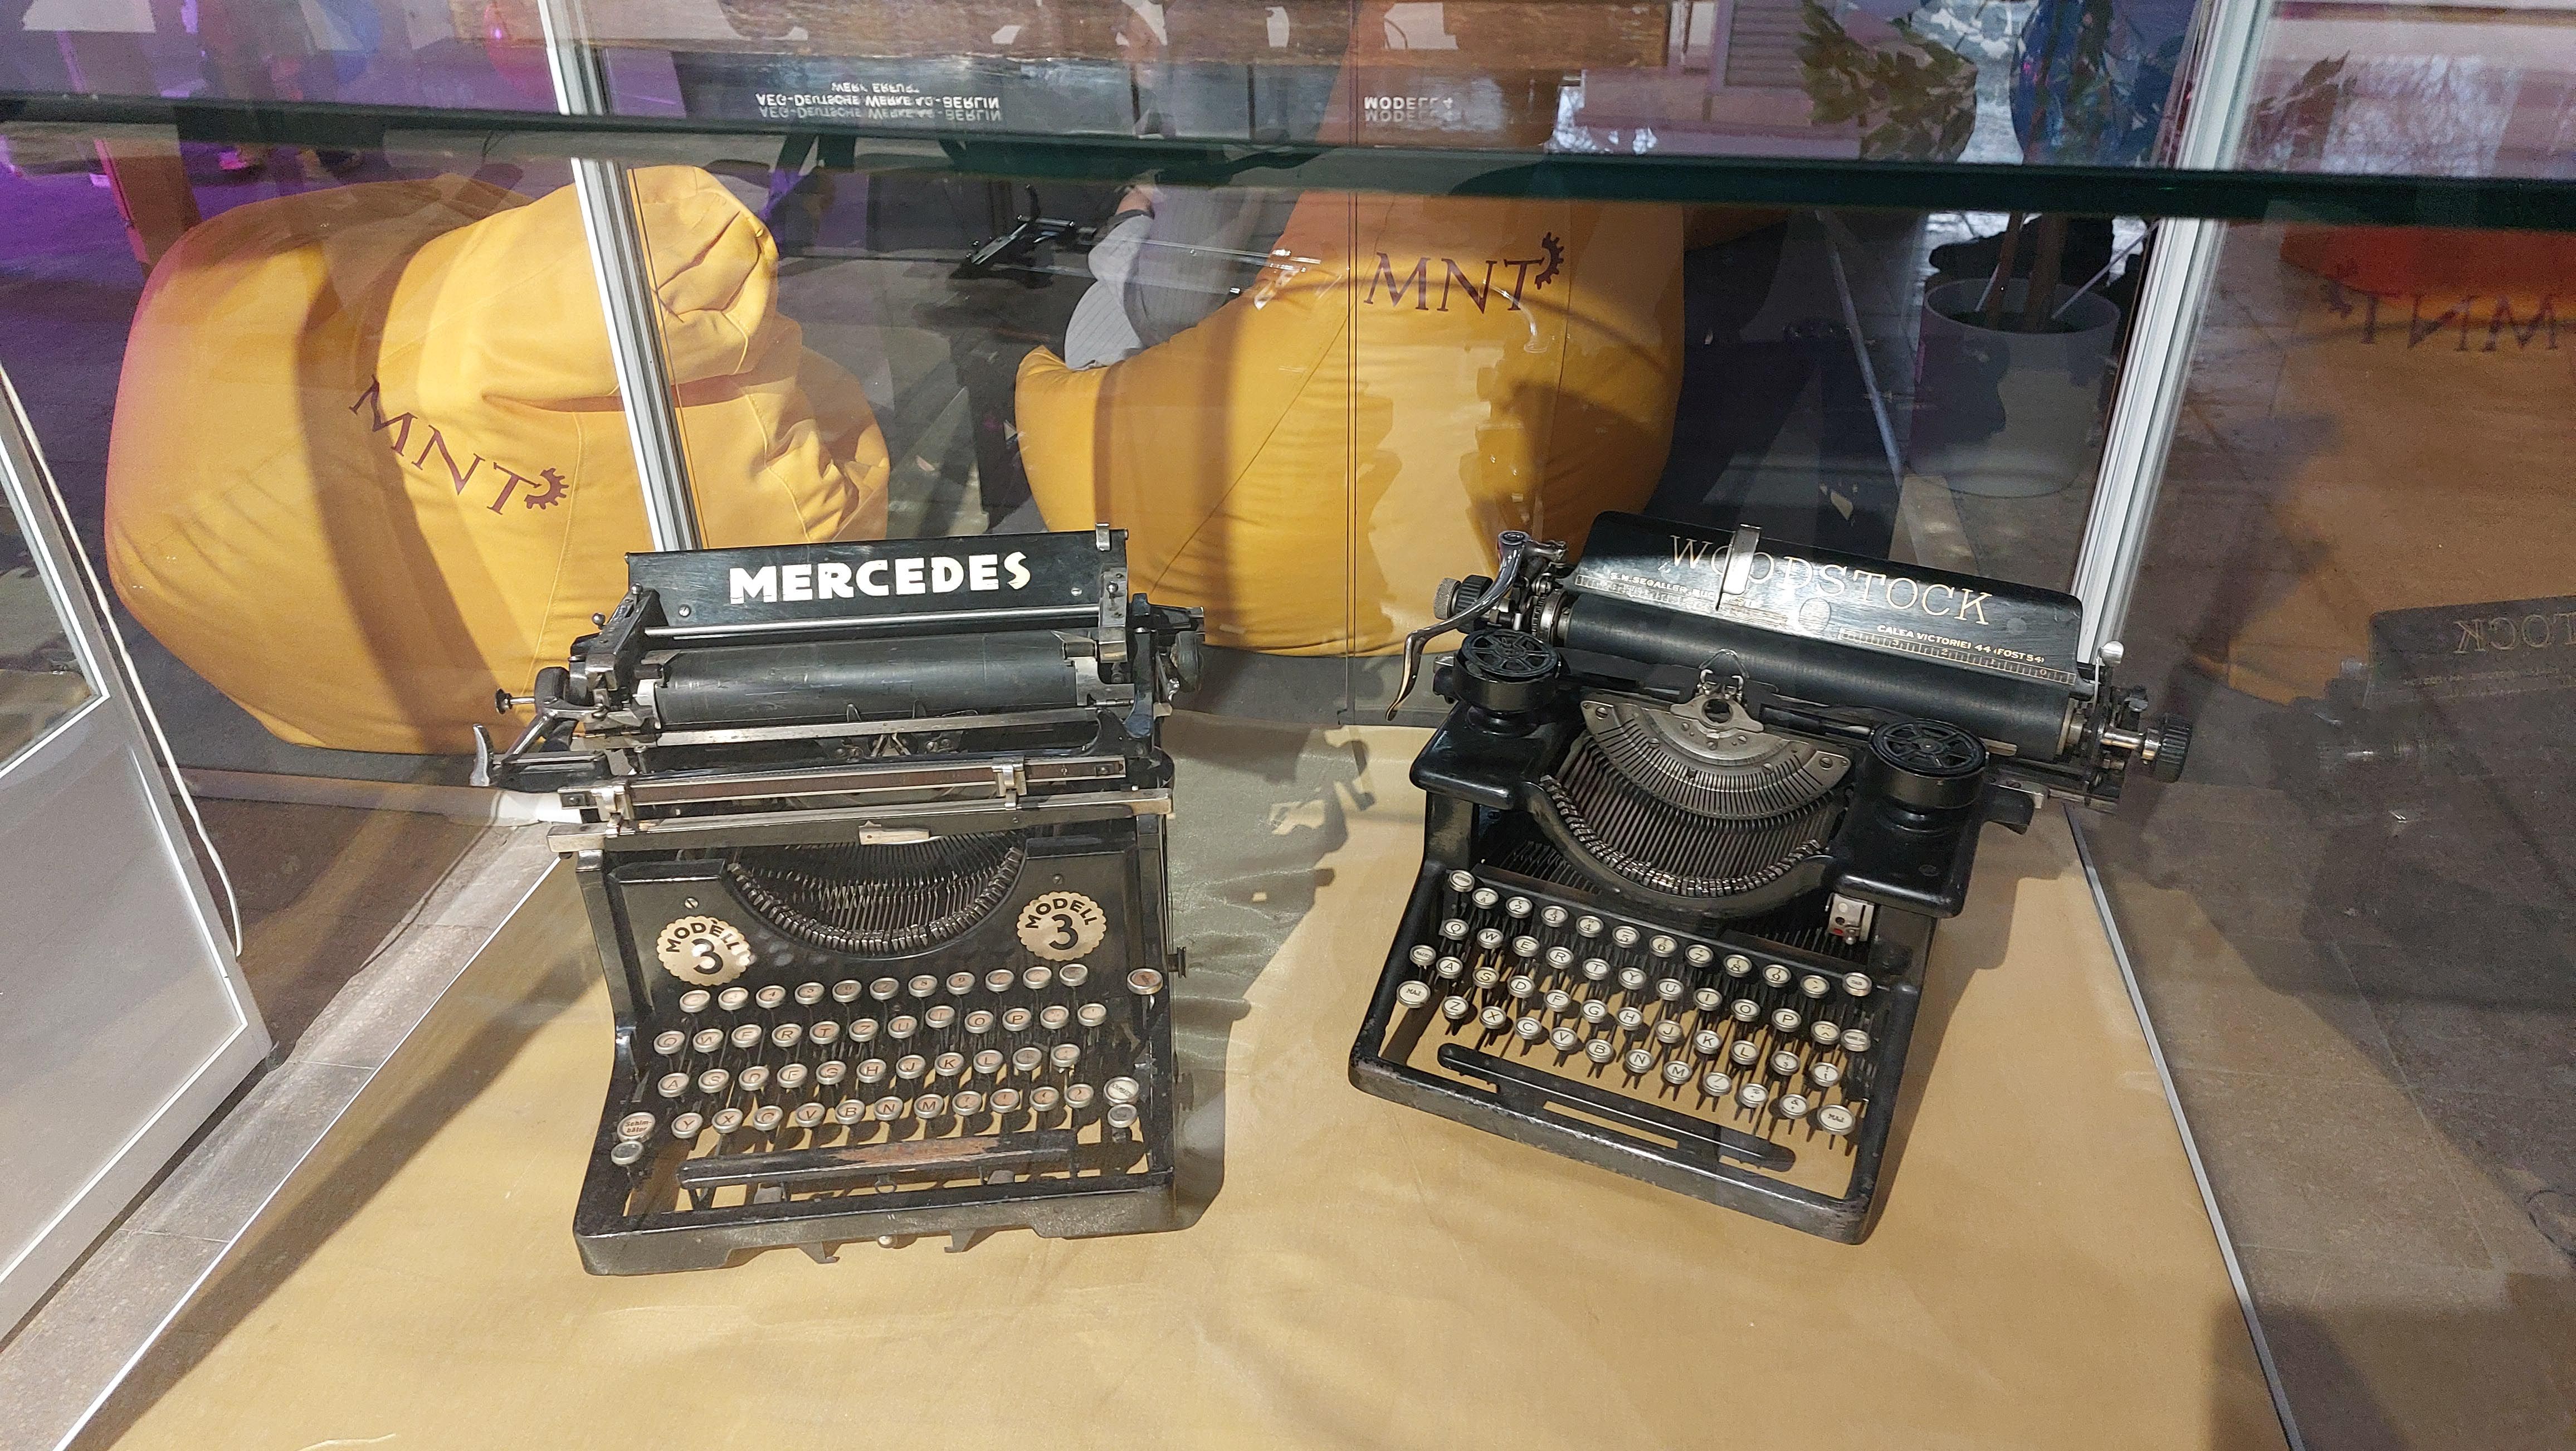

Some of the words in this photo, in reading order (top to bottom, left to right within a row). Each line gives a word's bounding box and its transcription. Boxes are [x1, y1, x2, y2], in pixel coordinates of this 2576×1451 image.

[1364, 252, 1545, 314] MNT
[349, 374, 541, 515] MNT
[729, 551, 1032, 605] MERCEDES
[1877, 625, 1914, 638] CALEA
[1916, 632, 1972, 649] VICTORIEI
[1974, 644, 1992, 653] 44
[1993, 647, 2026, 660] (FOST
[2026, 654, 2045, 664] 54)
[1025, 898, 1097, 929] MODELL
[1048, 913, 1079, 951] 3
[666, 922, 740, 953] MODELL
[691, 938, 724, 975] 3
[1451, 924, 1462, 933] Q
[1485, 933, 1498, 941] W
[1521, 941, 1531, 950] E
[1555, 952, 1566, 961] R
[1629, 972, 1639, 981] Y
[1665, 983, 1676, 992] U
[1705, 994, 1710, 1002] I
[1740, 1005, 1751, 1014] O
[1782, 1014, 1794, 1023] P
[1443, 962, 1453, 971] A
[1480, 973, 1492, 981] S
[1515, 981, 1526, 990] D
[1588, 1006, 1599, 1015] G
[1624, 1012, 1635, 1022] H
[1663, 1027, 1674, 1035] J
[1702, 1036, 1713, 1046] K
[1740, 1047, 1749, 1057] L
[1450, 1002, 1461, 1011] Z
[1487, 1011, 1500, 1021] X
[1523, 1022, 1534, 1031] C
[1559, 1033, 1569, 1041] V
[1594, 1045, 1606, 1054] B
[1633, 1054, 1646, 1064] N
[1672, 1067, 1685, 1077] M
[684, 1119, 696, 1129] Y
[724, 1115, 735, 1123] X
[761, 1112, 775, 1122] C
[806, 1110, 817, 1119] V
[845, 1107, 857, 1117] B
[883, 1103, 895, 1113] N
[922, 1101, 936, 1110] M
